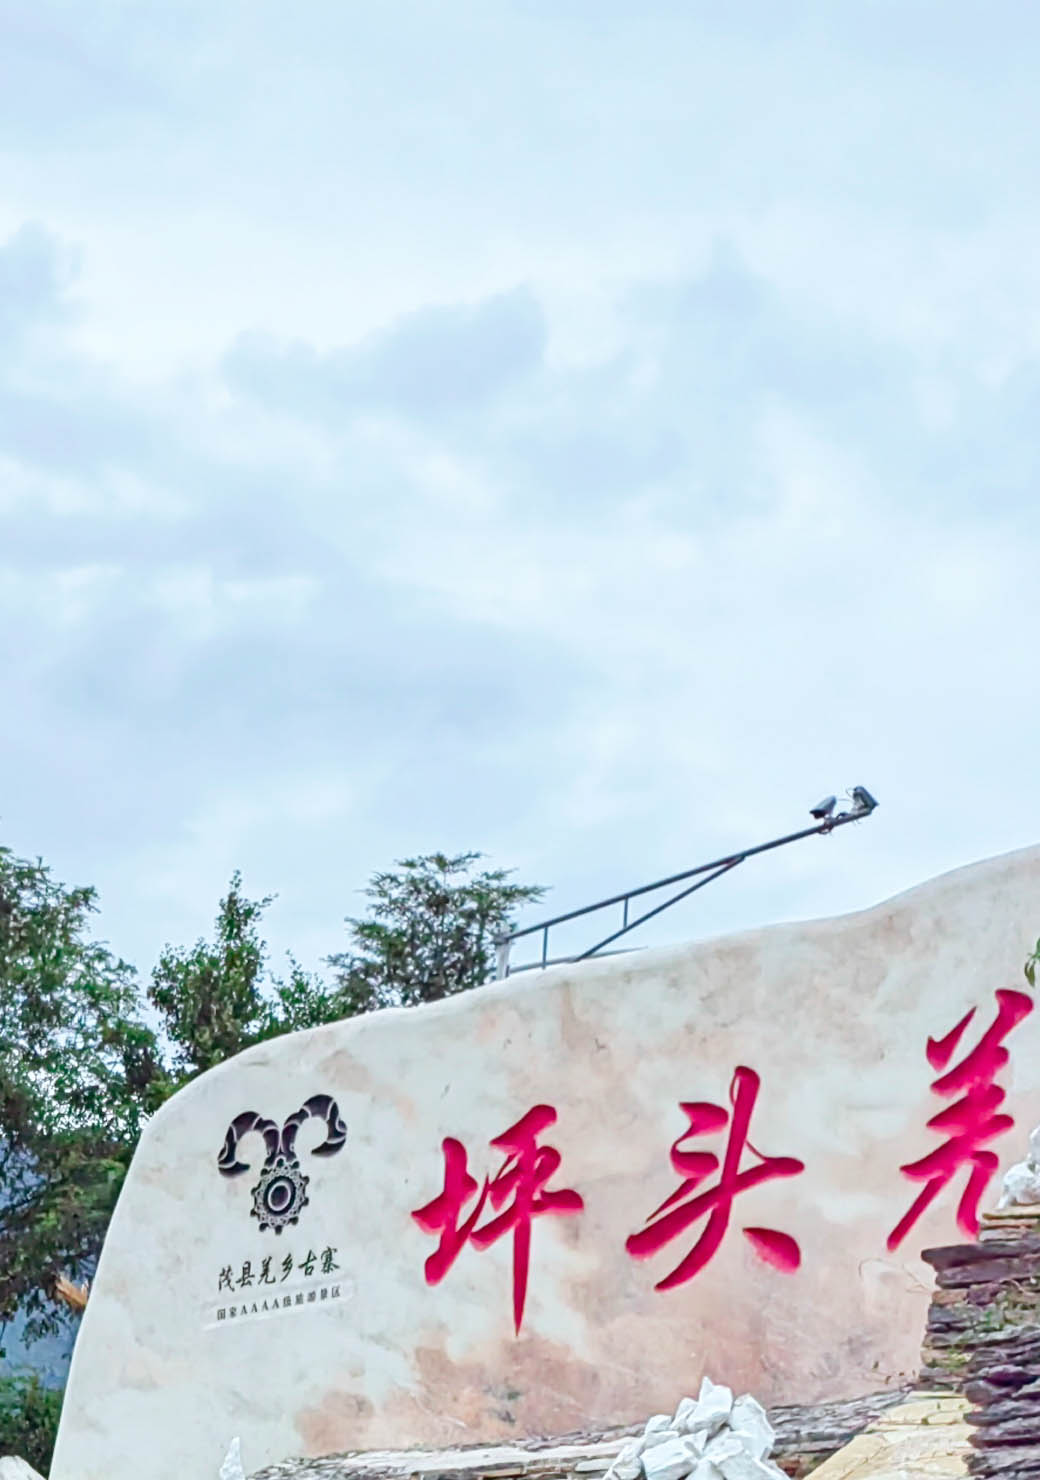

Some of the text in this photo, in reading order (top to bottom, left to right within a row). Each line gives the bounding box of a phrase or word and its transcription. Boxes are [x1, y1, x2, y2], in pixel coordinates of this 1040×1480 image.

[218, 1247, 340, 1292] 茂县羌乡古寨
